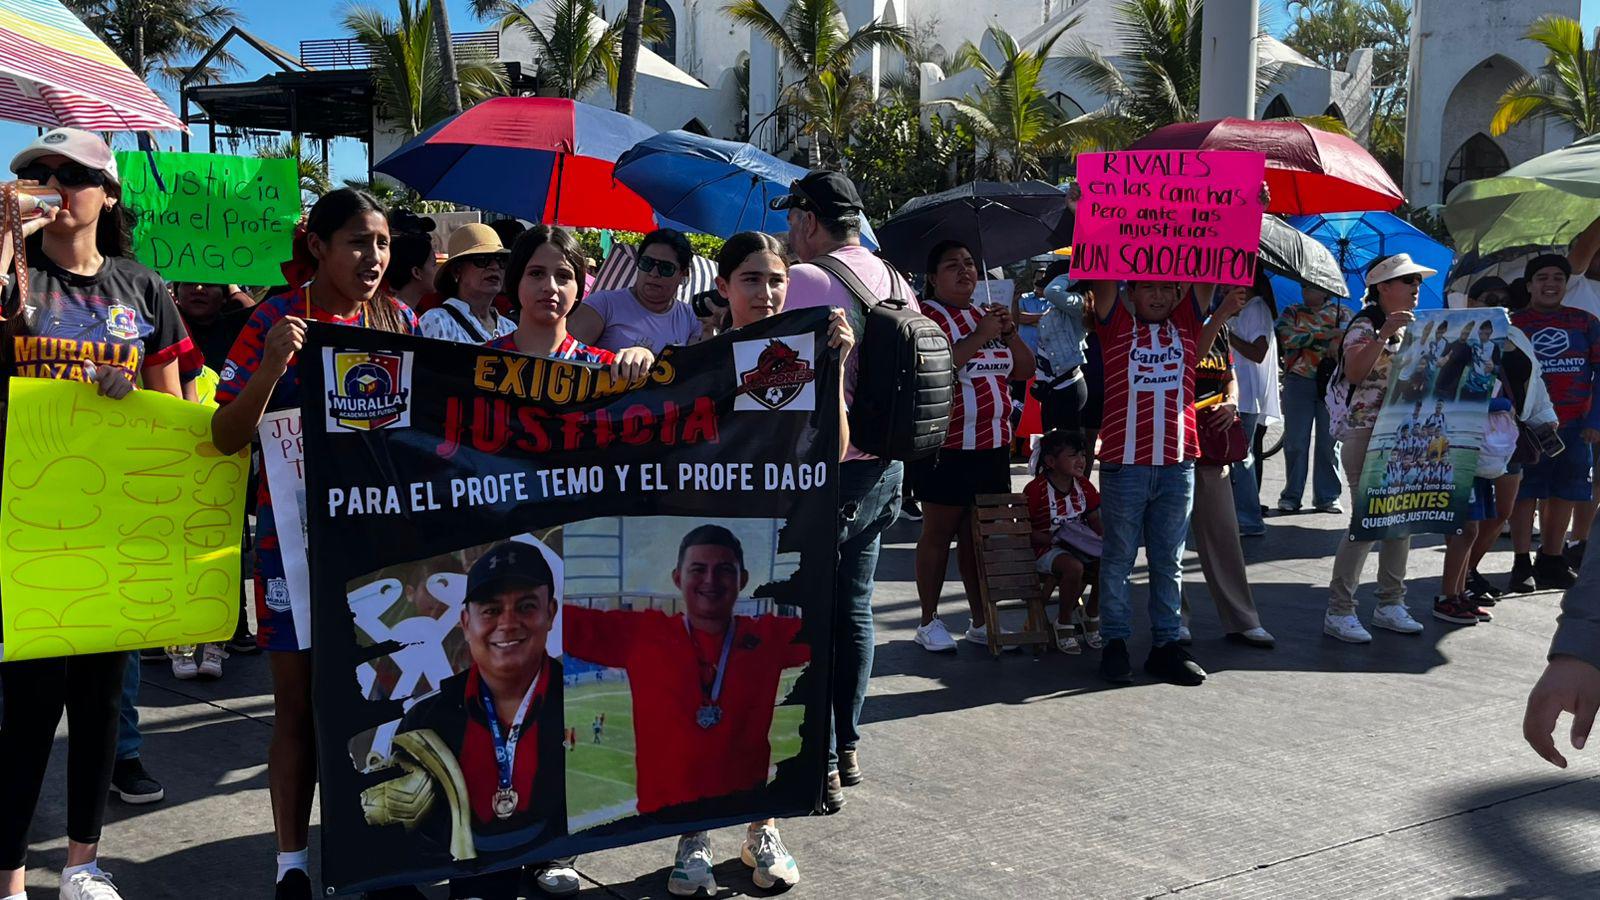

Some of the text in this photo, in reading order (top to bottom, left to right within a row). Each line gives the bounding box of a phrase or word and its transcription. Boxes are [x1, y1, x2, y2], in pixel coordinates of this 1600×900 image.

[1103, 152, 1211, 178] RIVALES
[1123, 178, 1151, 197] las
[189, 203, 210, 231] el
[1137, 206, 1178, 222] ante
[1192, 206, 1222, 223] las
[13, 336, 140, 373] MURALLA
[1541, 357, 1585, 367] NCANTO
[474, 349, 676, 404] EXIGIMS
[976, 362, 1010, 371] DAIKIN
[1142, 374, 1178, 384] DAIKIN
[333, 394, 403, 411] MURALLA
[69, 392, 210, 438] JUSTIC
[436, 396, 720, 458] JUSTICIA
[328, 461, 827, 517] PARA EL PROFE TEMO Y EL PROFE DAGO
[1367, 487, 1386, 496] Profe
[1404, 483, 1422, 492] Profe
[1423, 483, 1440, 491] Temo
[1368, 491, 1450, 514] INOCENTES
[1361, 511, 1455, 529] QUEREMOS JUSTICIA!!
[115, 446, 193, 648] REEMOS EN
